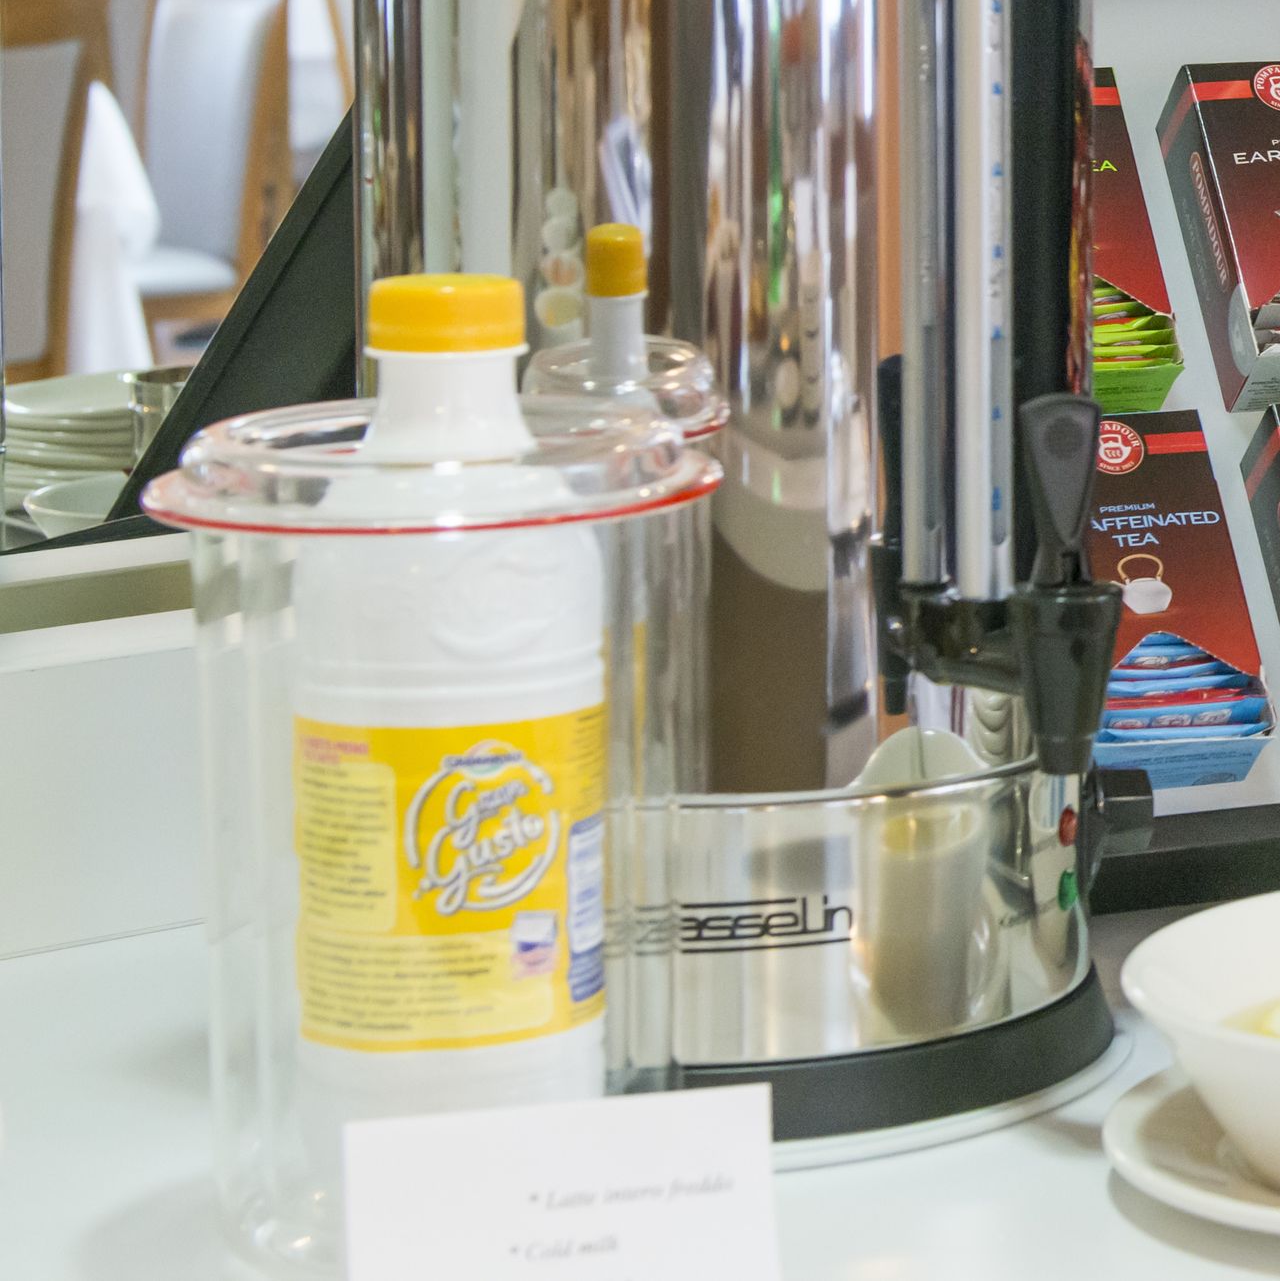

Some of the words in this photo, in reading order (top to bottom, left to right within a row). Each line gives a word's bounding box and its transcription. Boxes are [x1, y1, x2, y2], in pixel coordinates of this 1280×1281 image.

[1191, 160, 1229, 286] POMPADOUR
[1100, 424, 1141, 447] ADOUR
[1099, 503, 1156, 514] PREMIUM
[1112, 532, 1159, 547] TEA
[425, 808, 545, 916] Gusto
[637, 895, 853, 943] asselin
